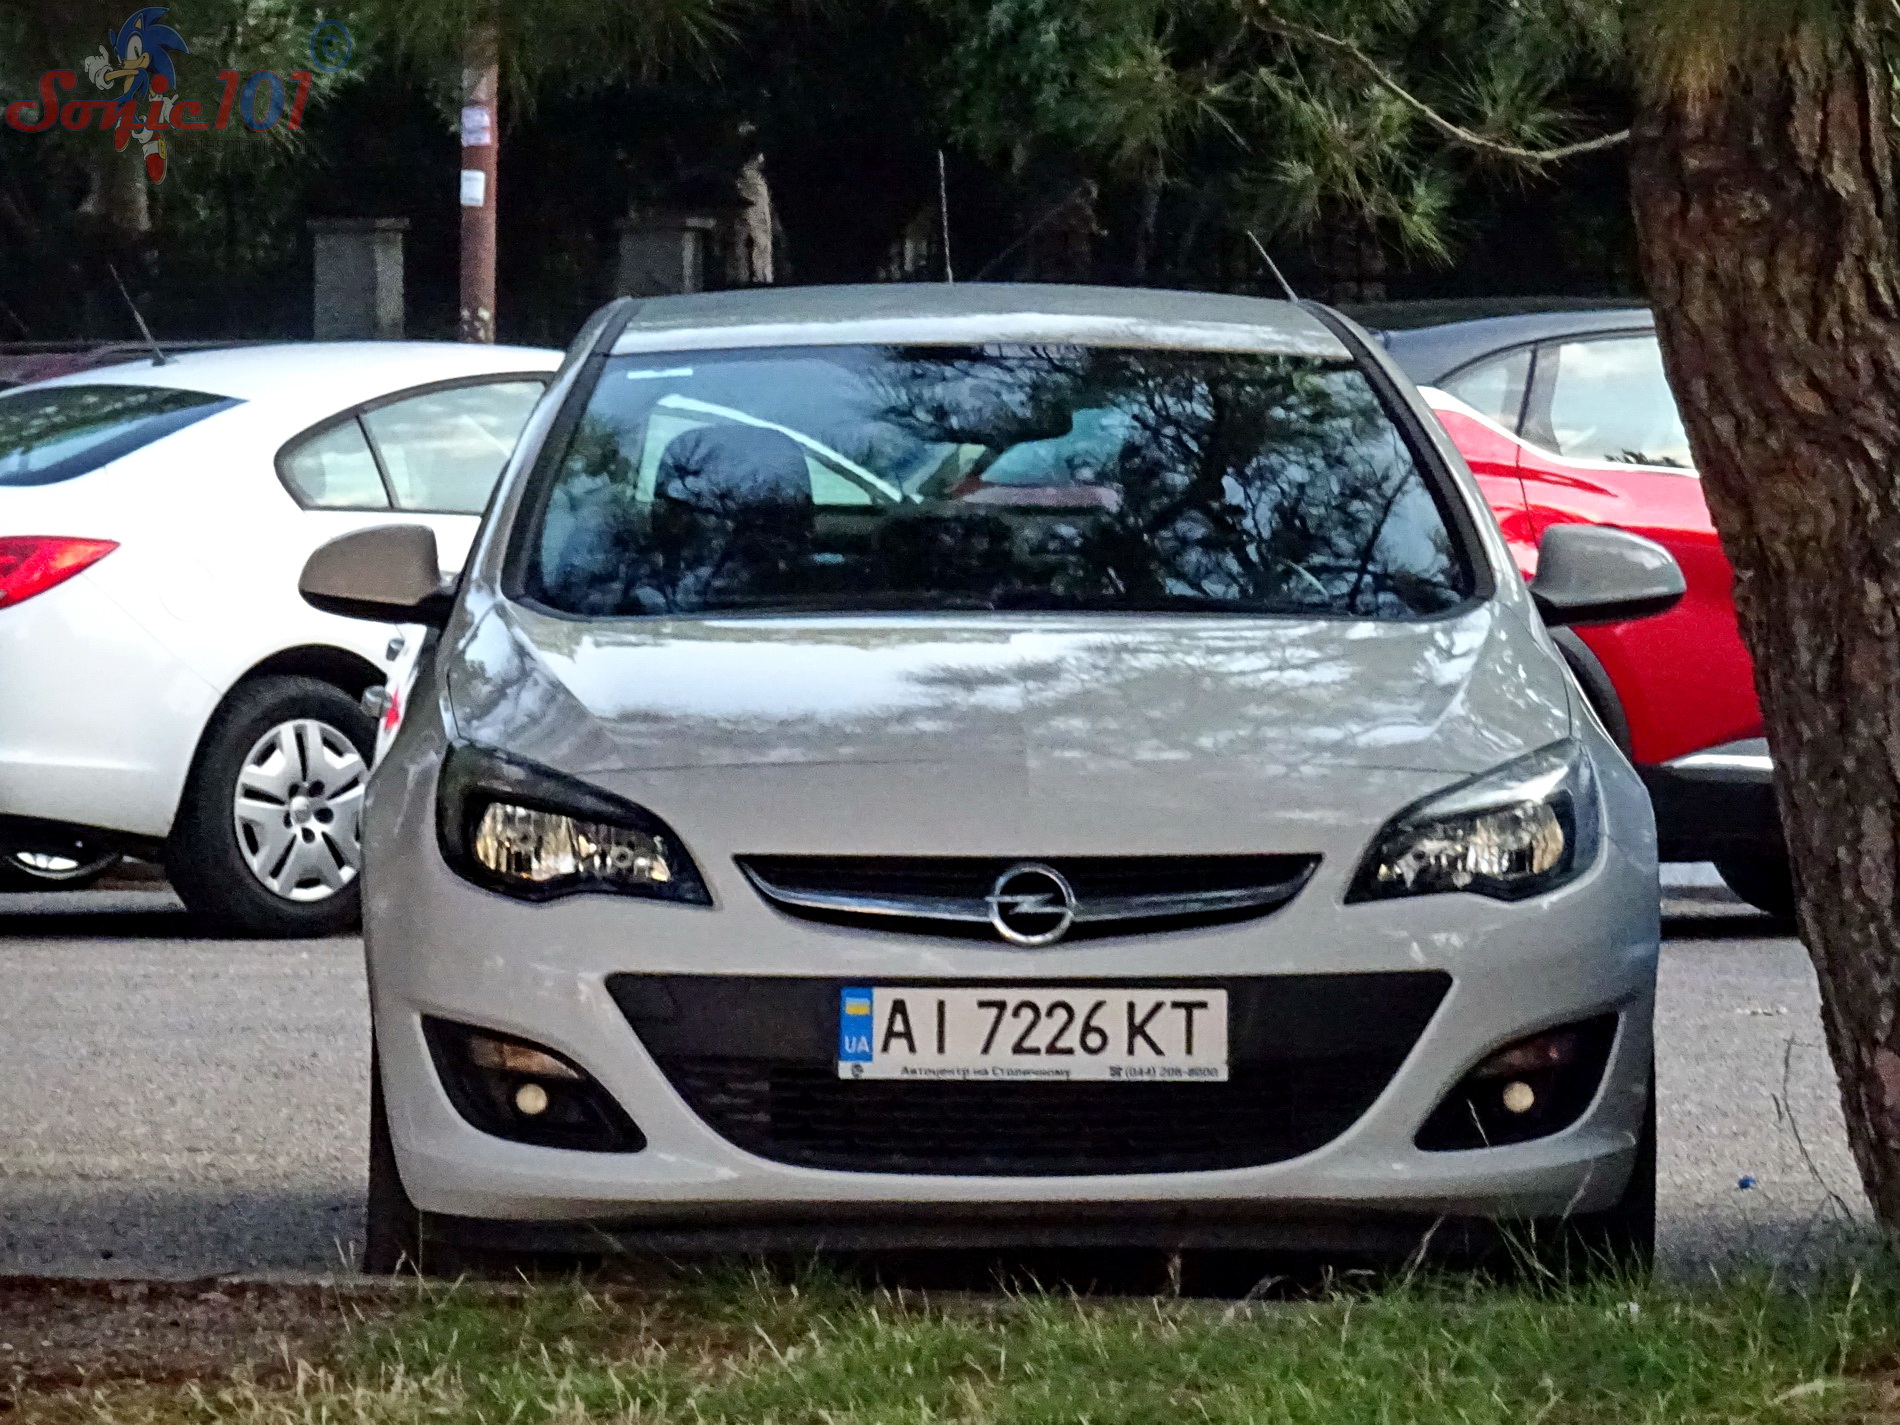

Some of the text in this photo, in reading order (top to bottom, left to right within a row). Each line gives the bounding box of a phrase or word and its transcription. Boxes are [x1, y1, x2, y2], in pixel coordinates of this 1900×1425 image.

[845, 1036, 870, 1053] UA
[977, 1000, 1109, 1055] 7226
[1126, 1000, 1208, 1057] KT
